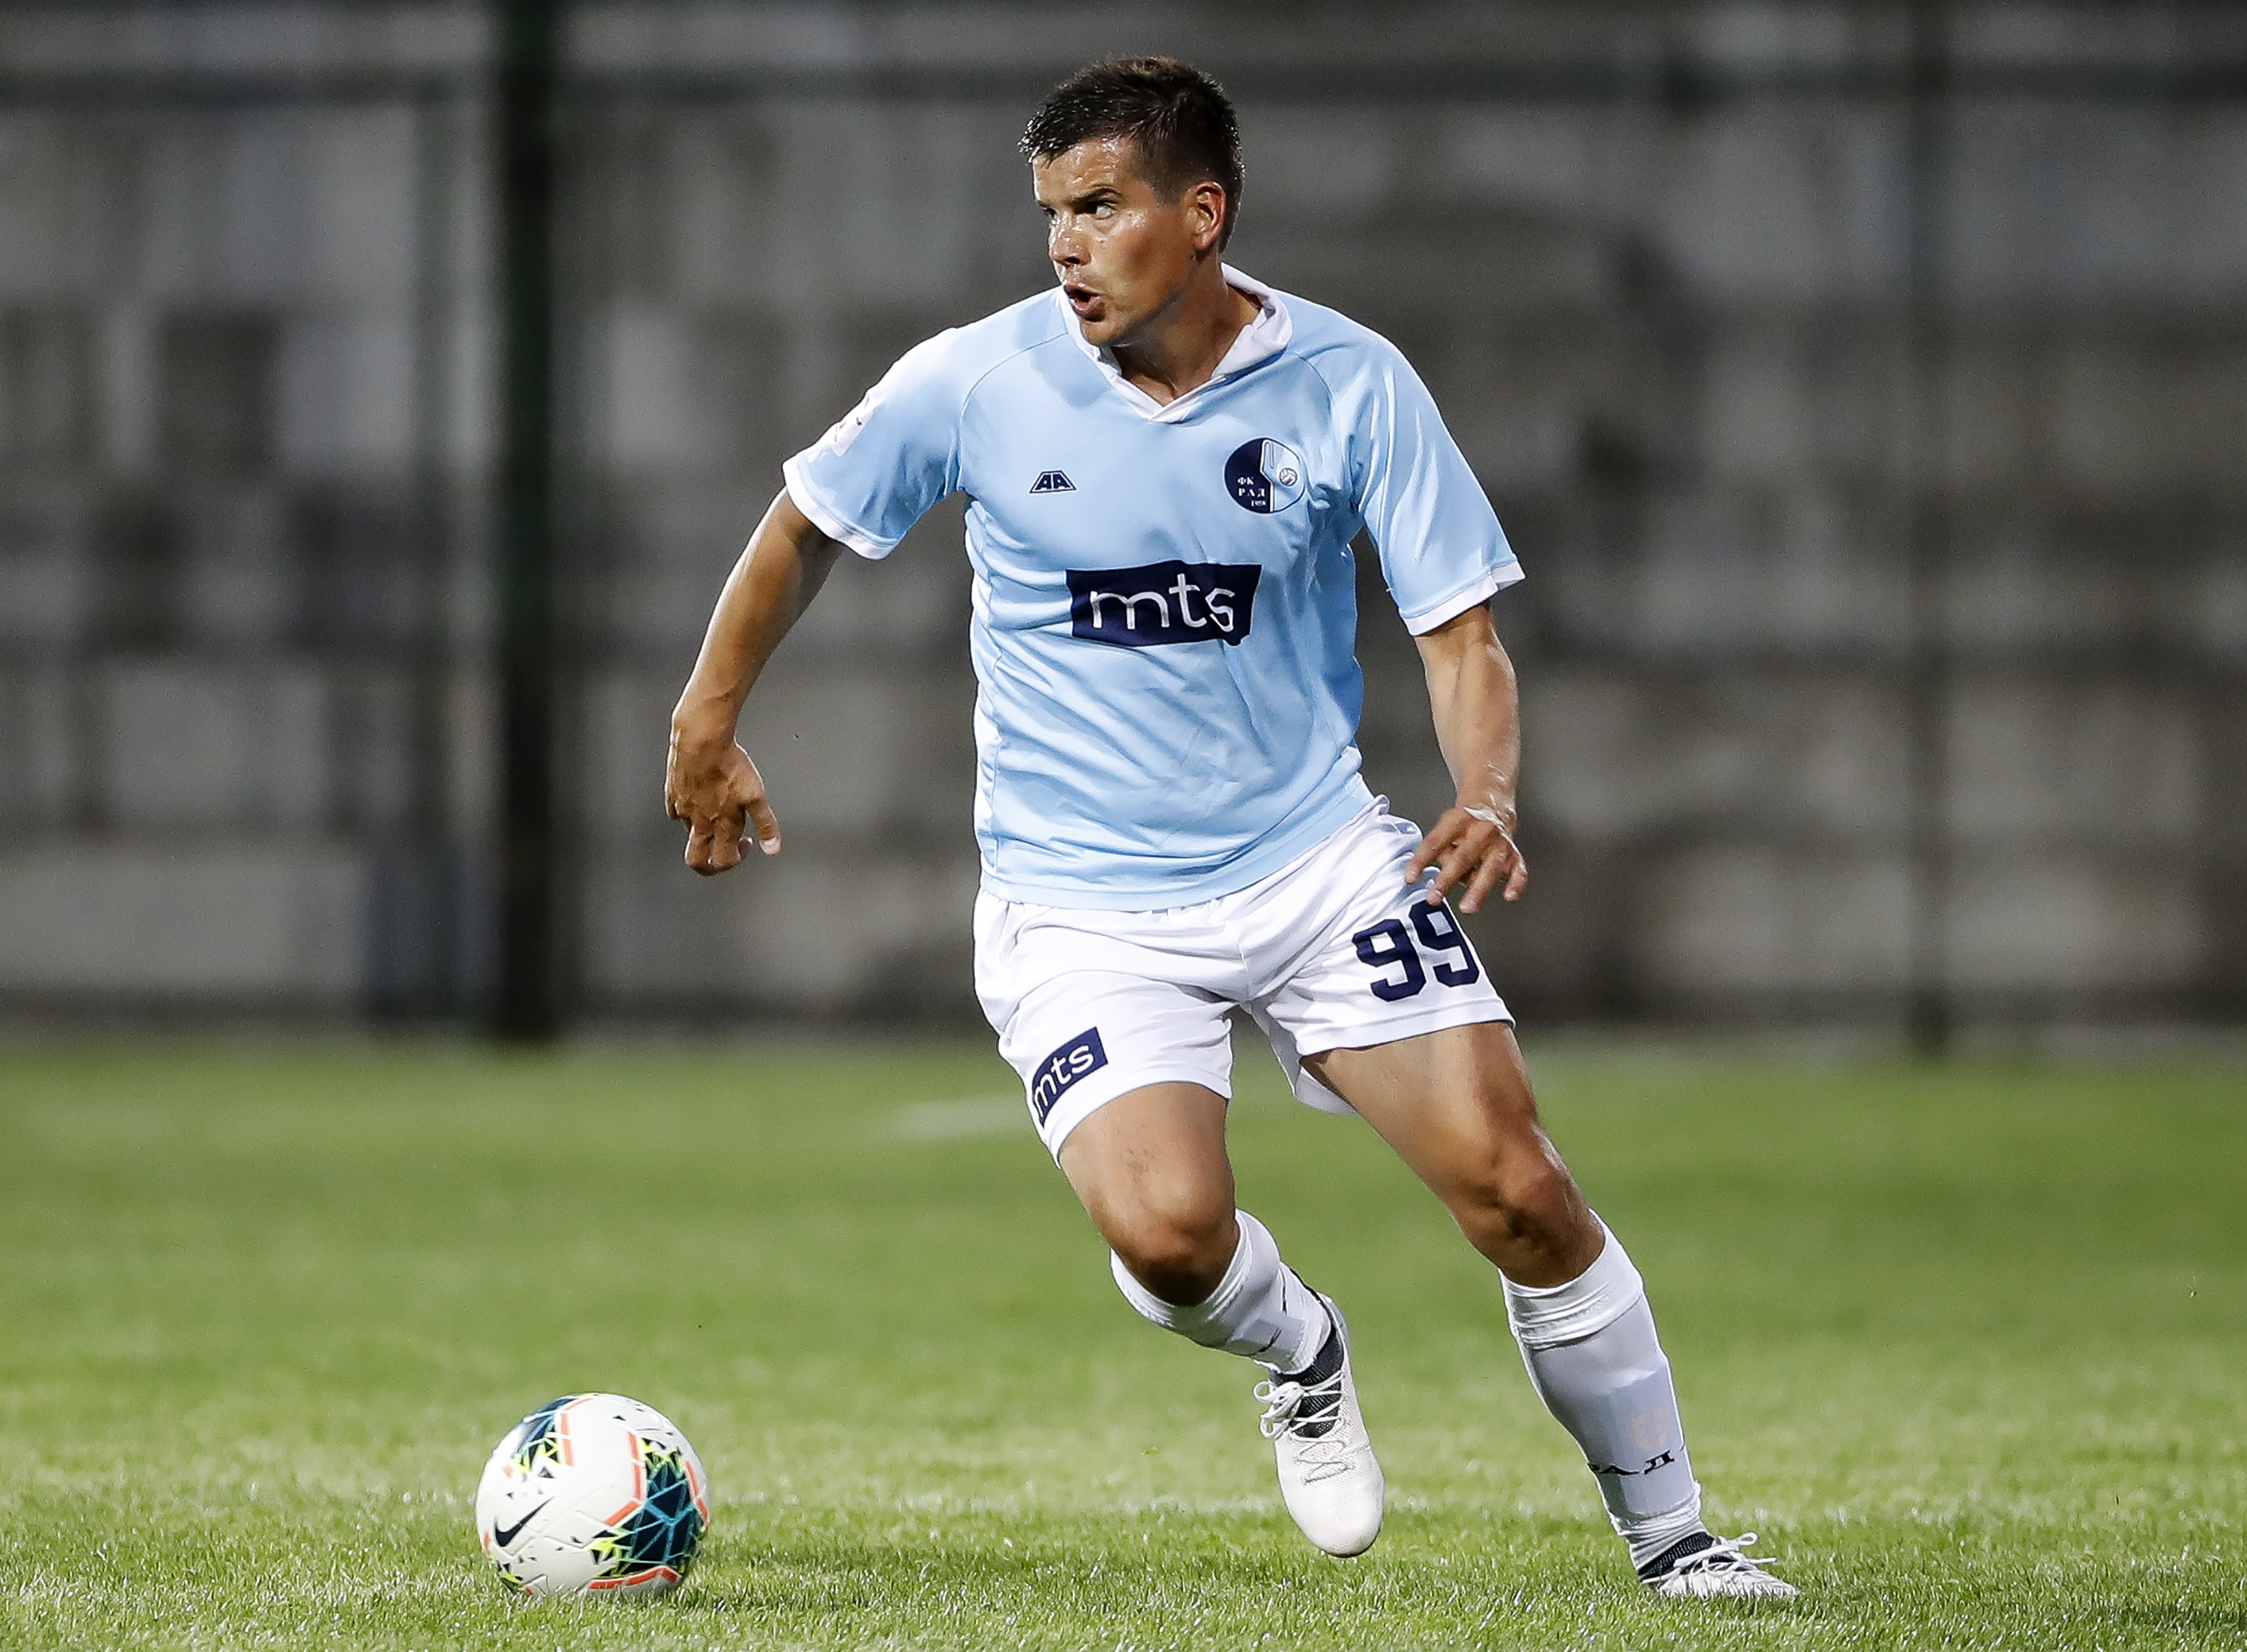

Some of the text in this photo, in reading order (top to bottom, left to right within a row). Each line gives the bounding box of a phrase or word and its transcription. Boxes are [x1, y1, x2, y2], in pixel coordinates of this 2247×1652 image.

[1089, 573, 1236, 632] mts
[1351, 898, 1480, 1002] 99
[1034, 1045, 1095, 1118] mts
